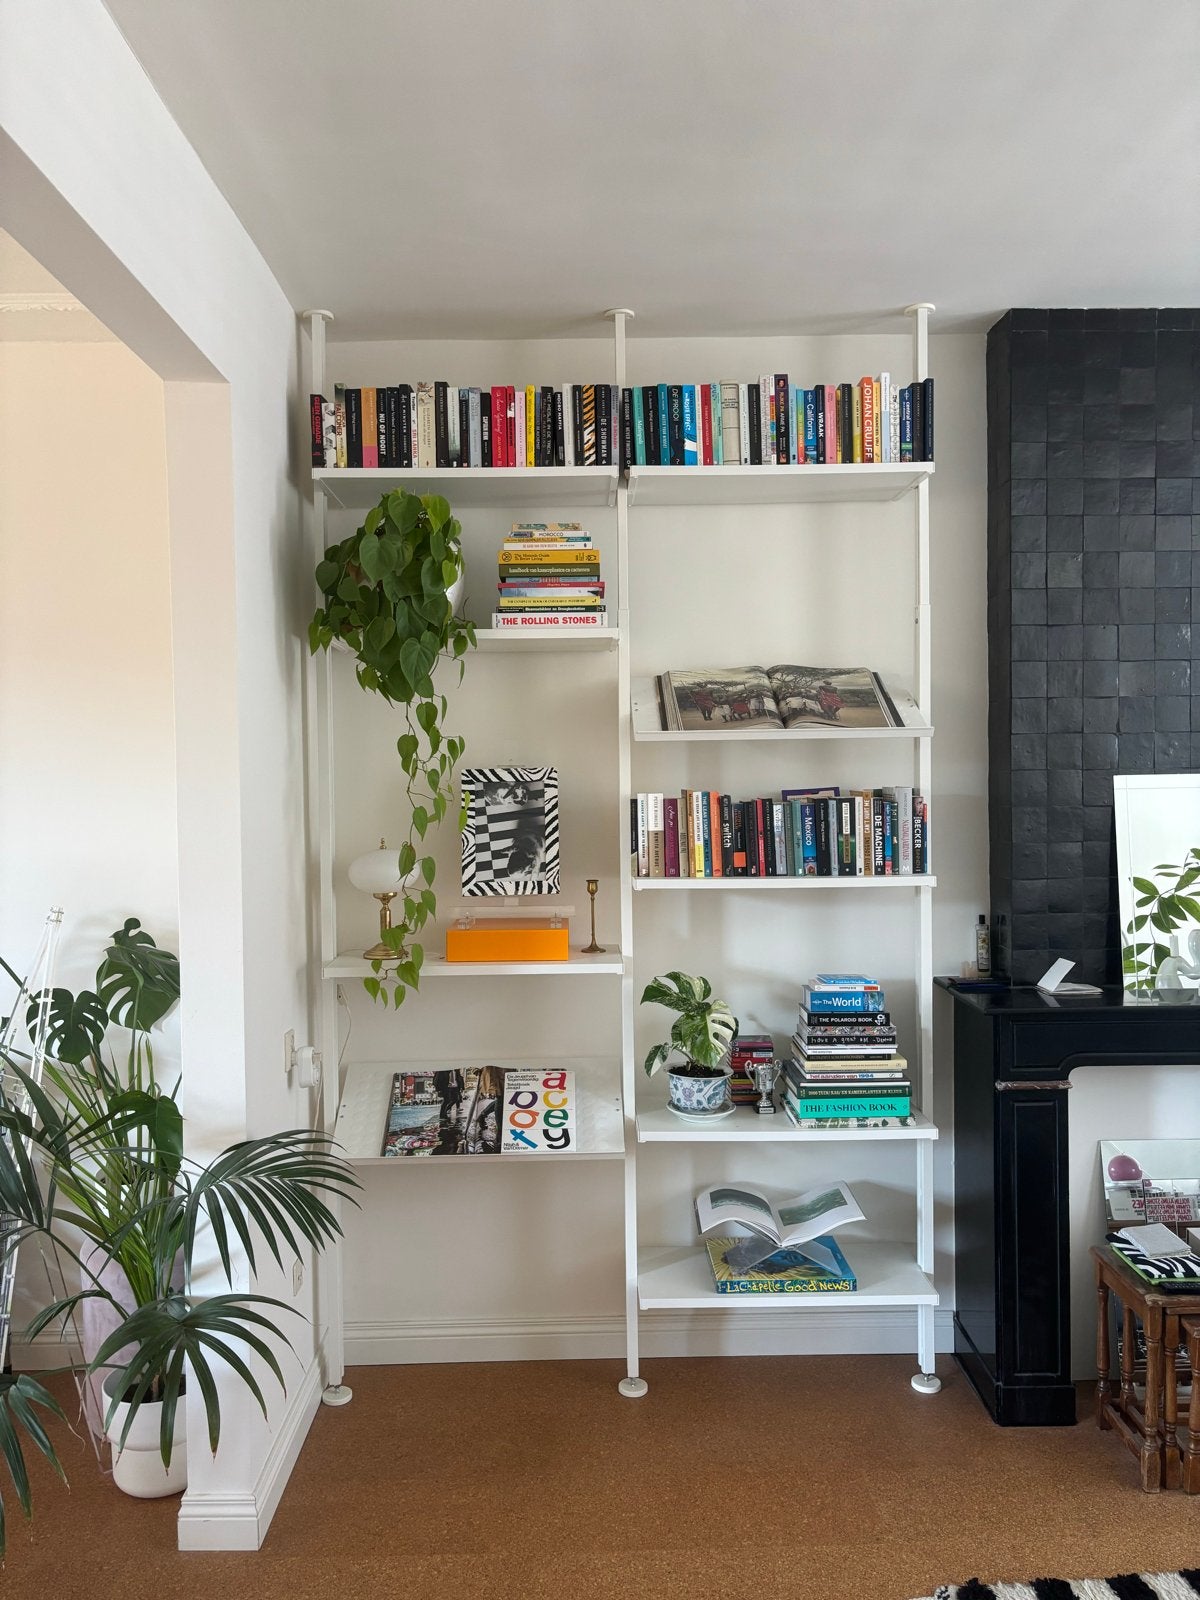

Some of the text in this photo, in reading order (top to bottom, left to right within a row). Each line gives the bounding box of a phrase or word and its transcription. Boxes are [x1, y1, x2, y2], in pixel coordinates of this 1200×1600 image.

[672, 388, 678, 398] DE
[379, 413, 385, 423] NU
[600, 418, 606, 426] DE
[806, 404, 814, 440] California
[864, 383, 872, 458] JOHAN CRUIJFF
[380, 424, 385, 433] OF
[562, 616, 597, 624] STONES
[874, 816, 882, 826] DE
[721, 822, 730, 848] switch
[804, 817, 813, 846] Mexico
[914, 820, 922, 848] BECKER
[832, 998, 861, 1006] World
[804, 1104, 824, 1112] THE
[826, 1104, 866, 1112] FASHION
[544, 1109, 568, 1128] e
[726, 1280, 854, 1293] LaChapelle Good News!
